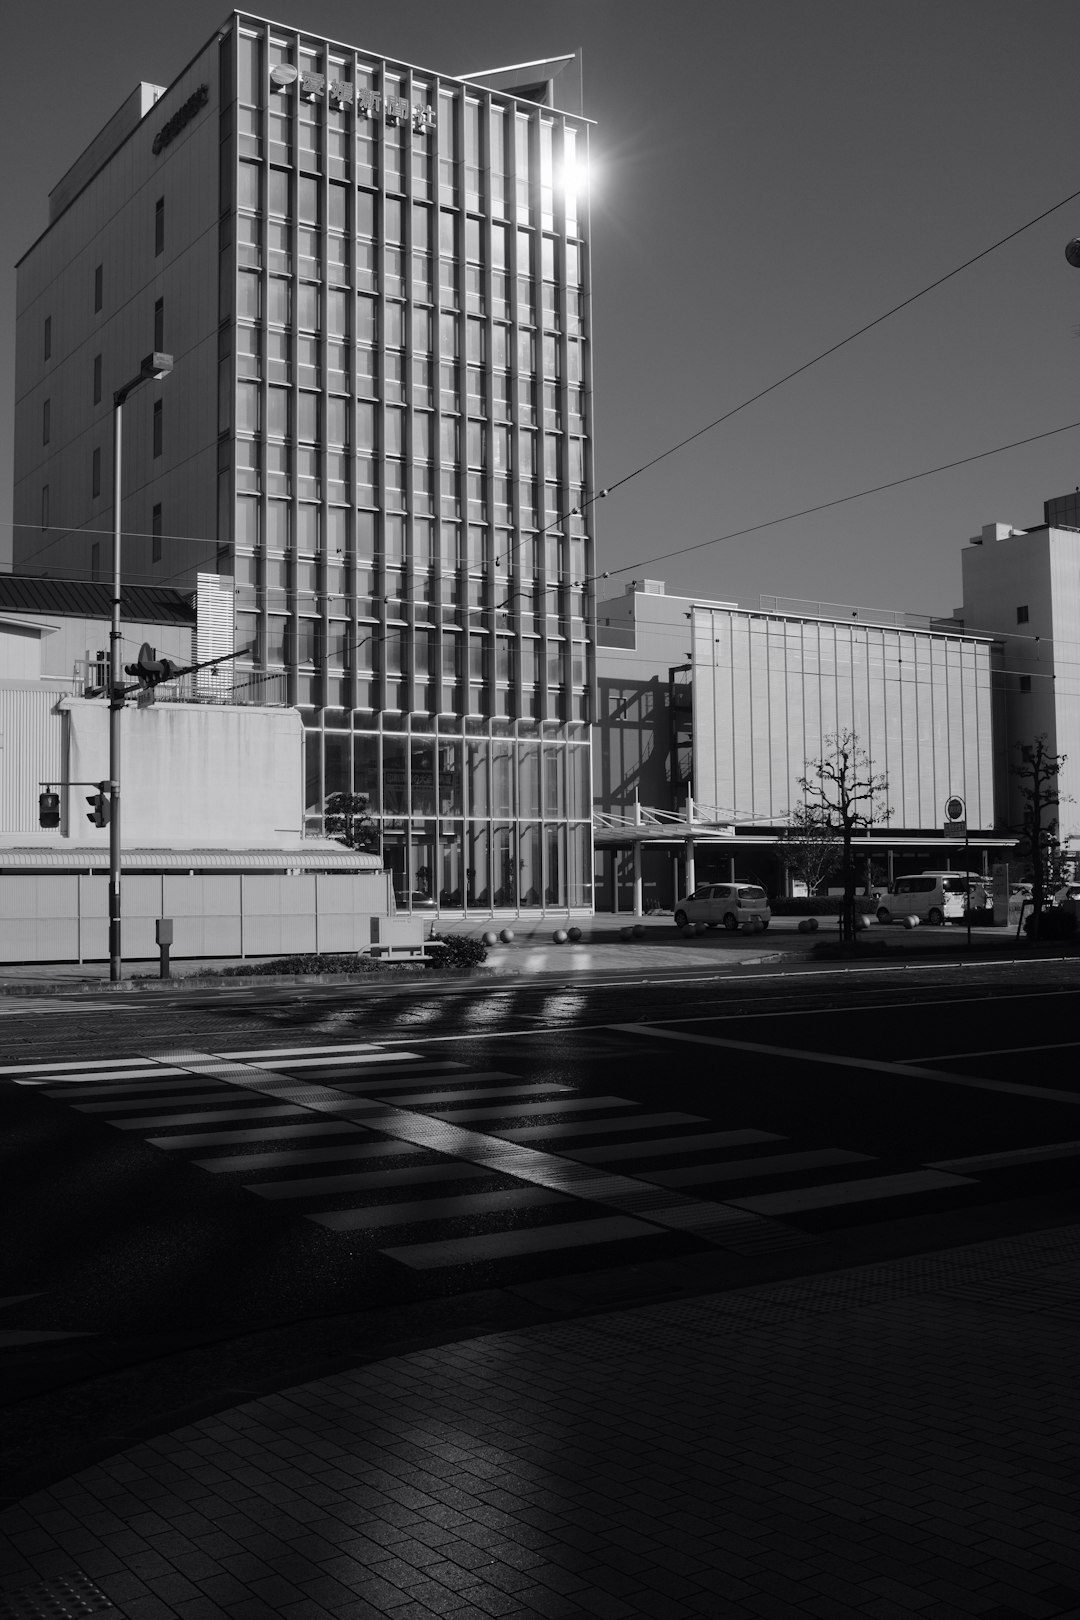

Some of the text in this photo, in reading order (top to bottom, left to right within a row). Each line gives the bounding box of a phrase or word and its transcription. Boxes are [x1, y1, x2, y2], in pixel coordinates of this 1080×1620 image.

[302, 70, 437, 128] 愛媛新聞社
